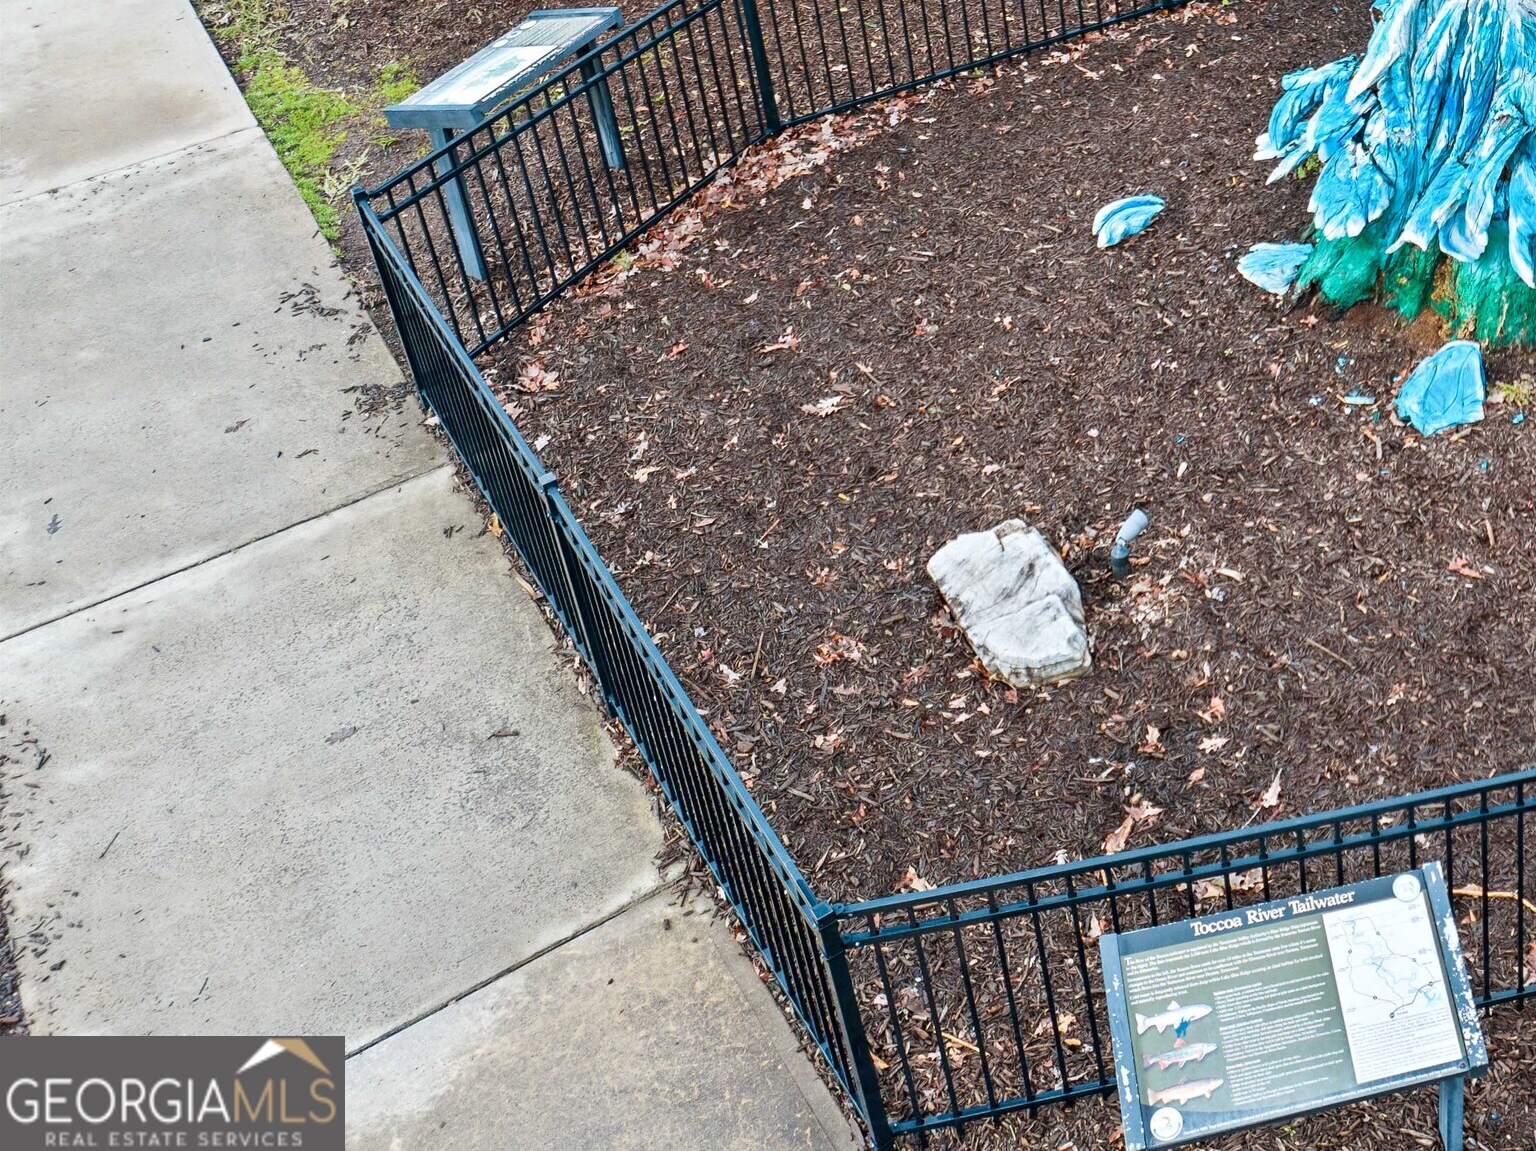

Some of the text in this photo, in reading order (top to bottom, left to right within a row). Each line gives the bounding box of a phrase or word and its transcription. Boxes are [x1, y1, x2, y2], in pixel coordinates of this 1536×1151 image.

[1190, 917, 1243, 937] Toccoa
[1245, 905, 1286, 925] River
[1288, 891, 1356, 915] Tailwater
